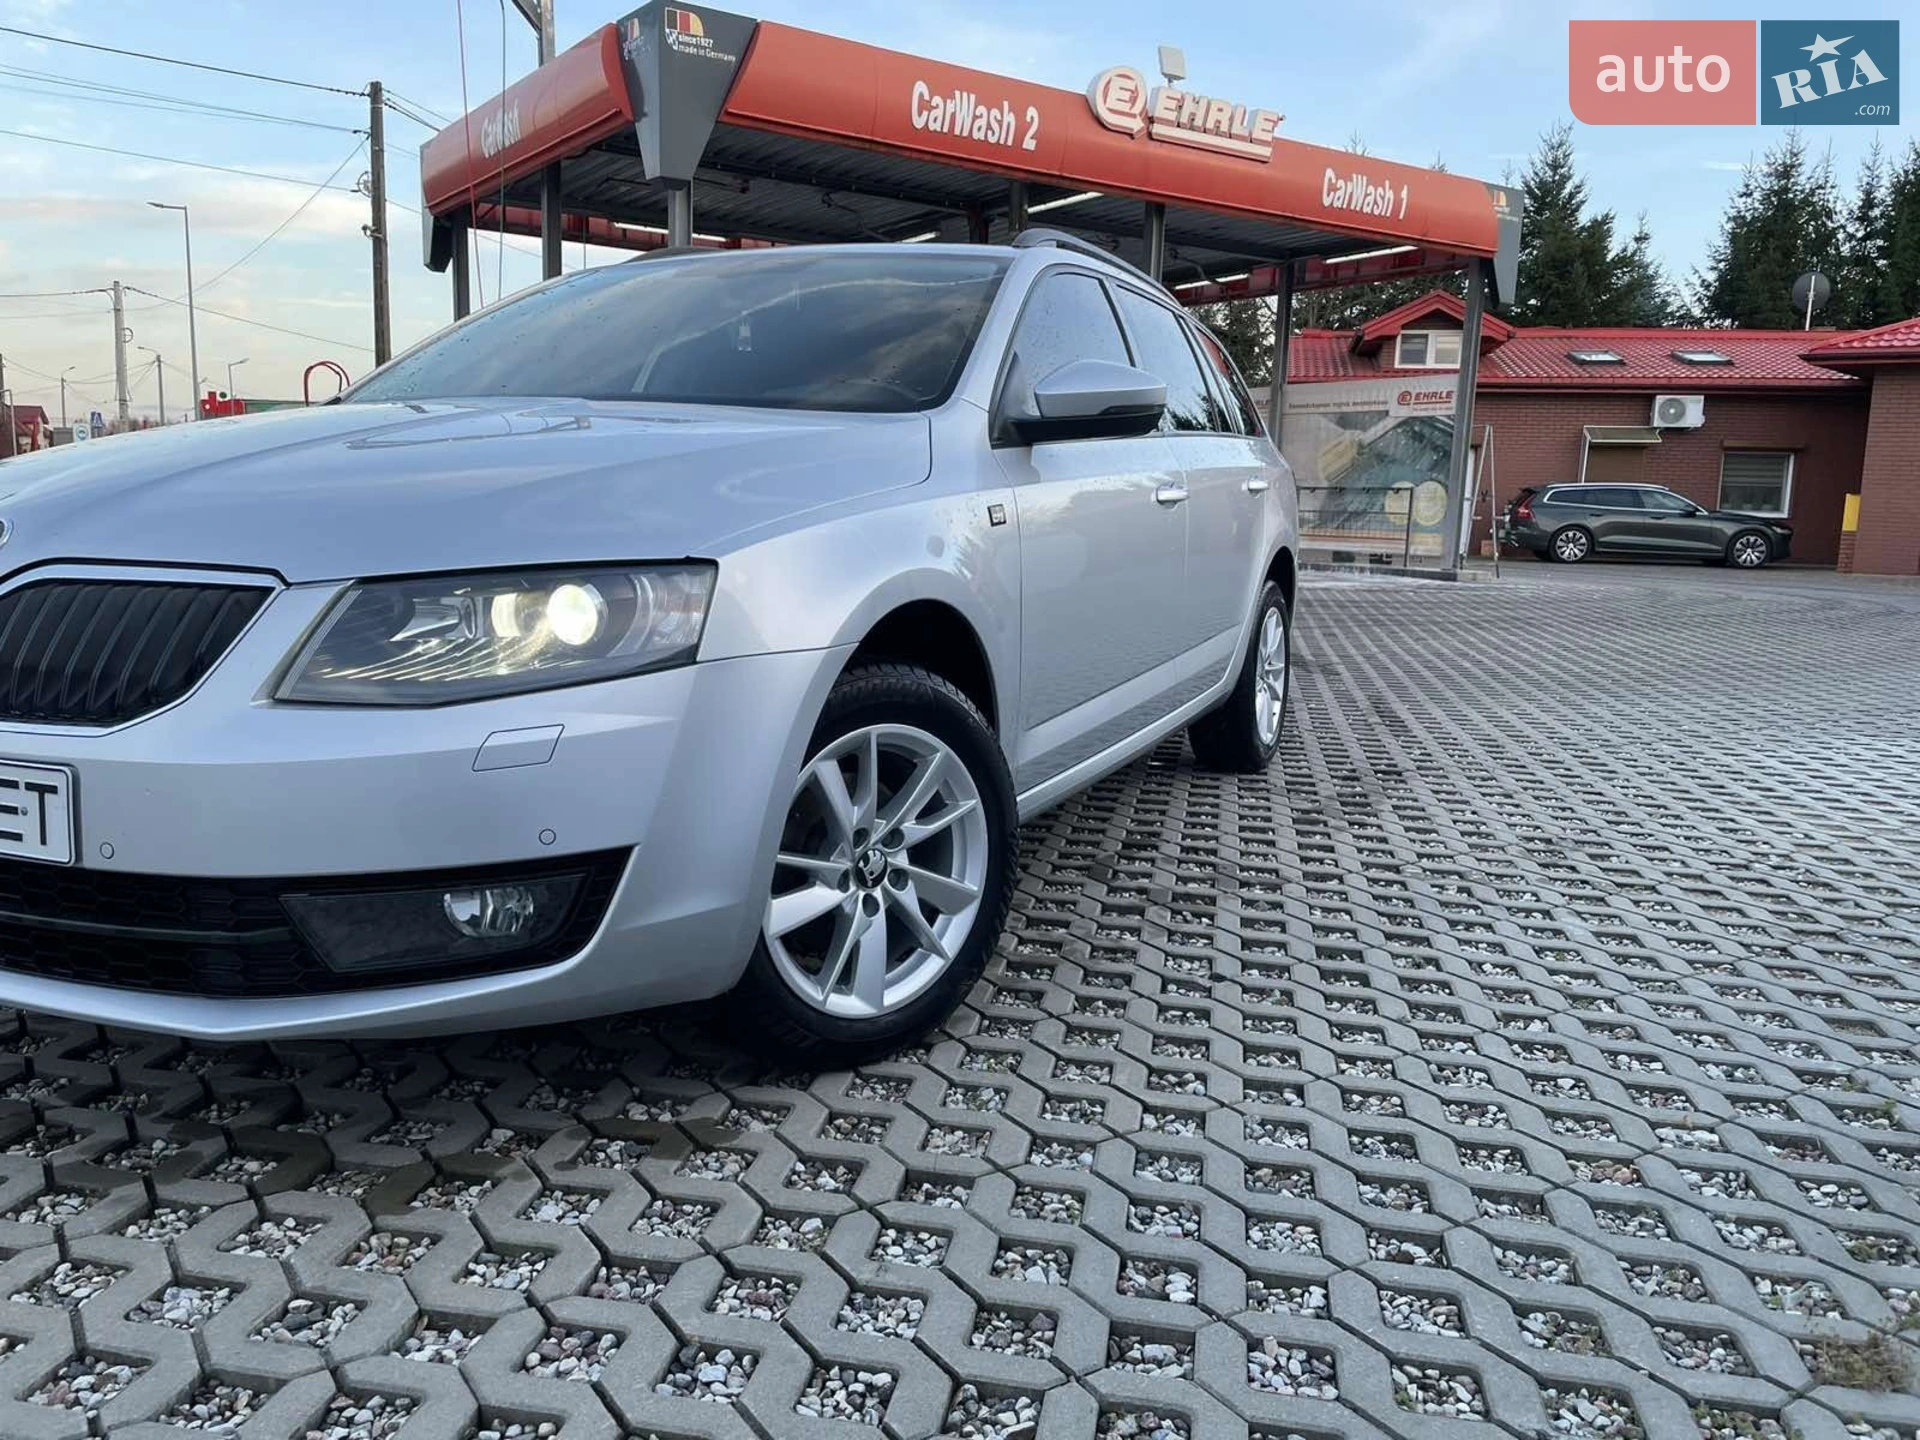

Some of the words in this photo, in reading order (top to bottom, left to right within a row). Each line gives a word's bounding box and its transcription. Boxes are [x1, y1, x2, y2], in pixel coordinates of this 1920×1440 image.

[678, 45, 697, 55] made
[706, 48, 736, 61] Germany
[911, 80, 1015, 146] CarWash
[1022, 105, 1040, 151] 2
[1150, 87, 1279, 144] EHRLE
[1322, 167, 1394, 217] CarWash
[1399, 184, 1408, 220] 1
[1414, 390, 1454, 401] EHRLE
